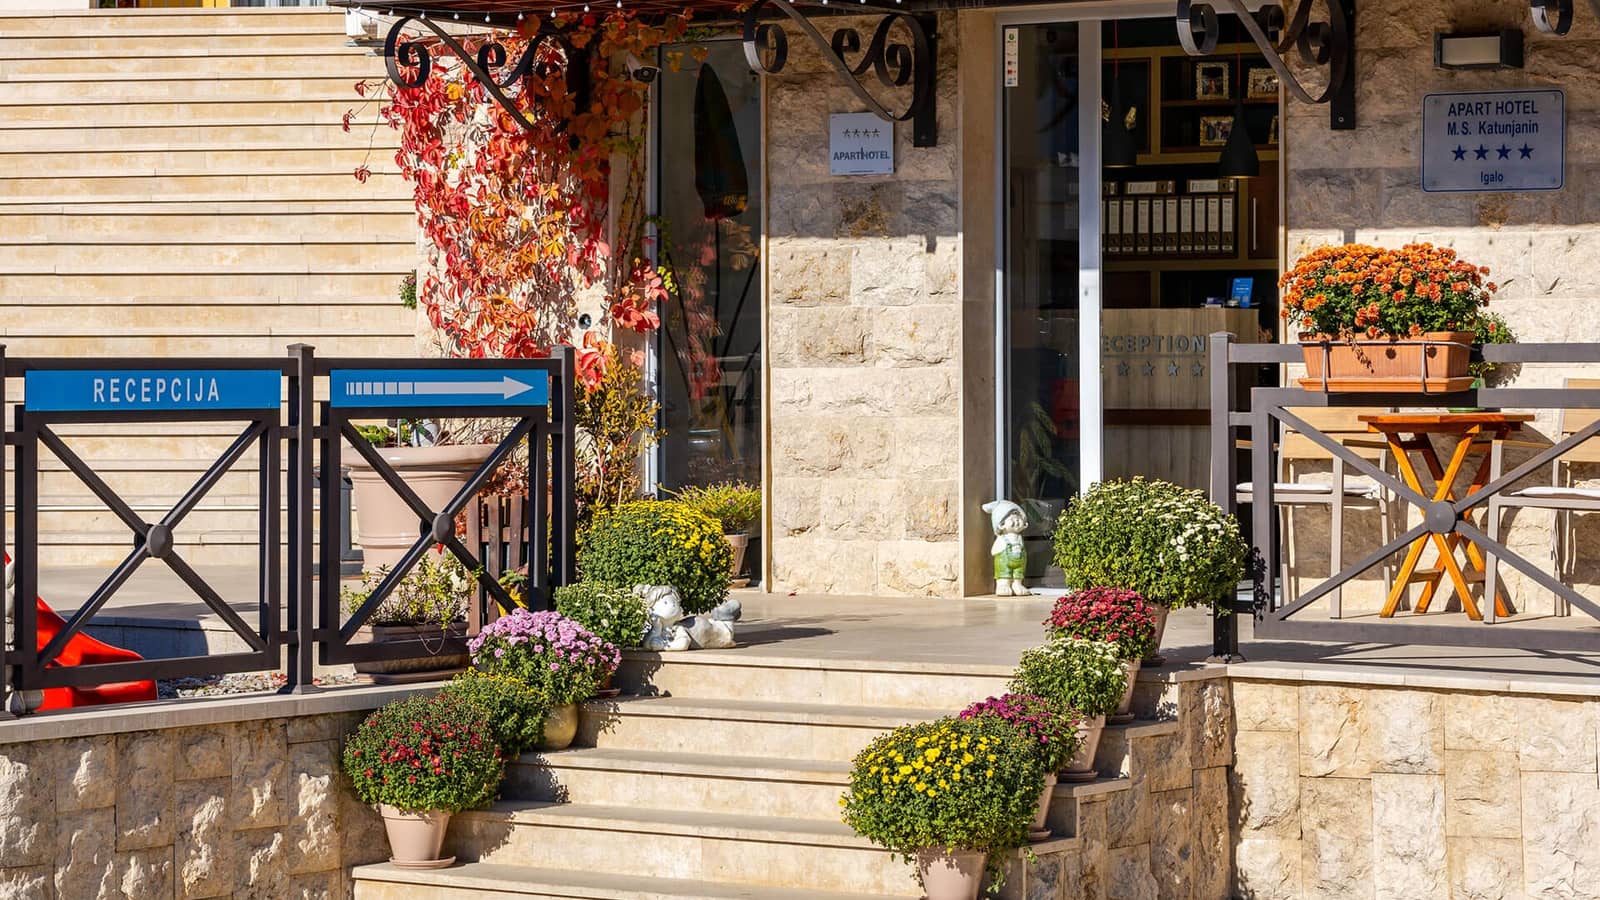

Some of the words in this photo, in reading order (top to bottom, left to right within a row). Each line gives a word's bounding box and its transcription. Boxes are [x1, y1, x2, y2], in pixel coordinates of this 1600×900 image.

[1448, 101, 1492, 117] APART
[1496, 100, 1538, 115] HOTEL
[1478, 119, 1539, 137] Katunjanin
[1480, 171, 1504, 185] Igalo
[1103, 335, 1206, 353] ECEPTION
[93, 377, 220, 403] RECEPCIJA
